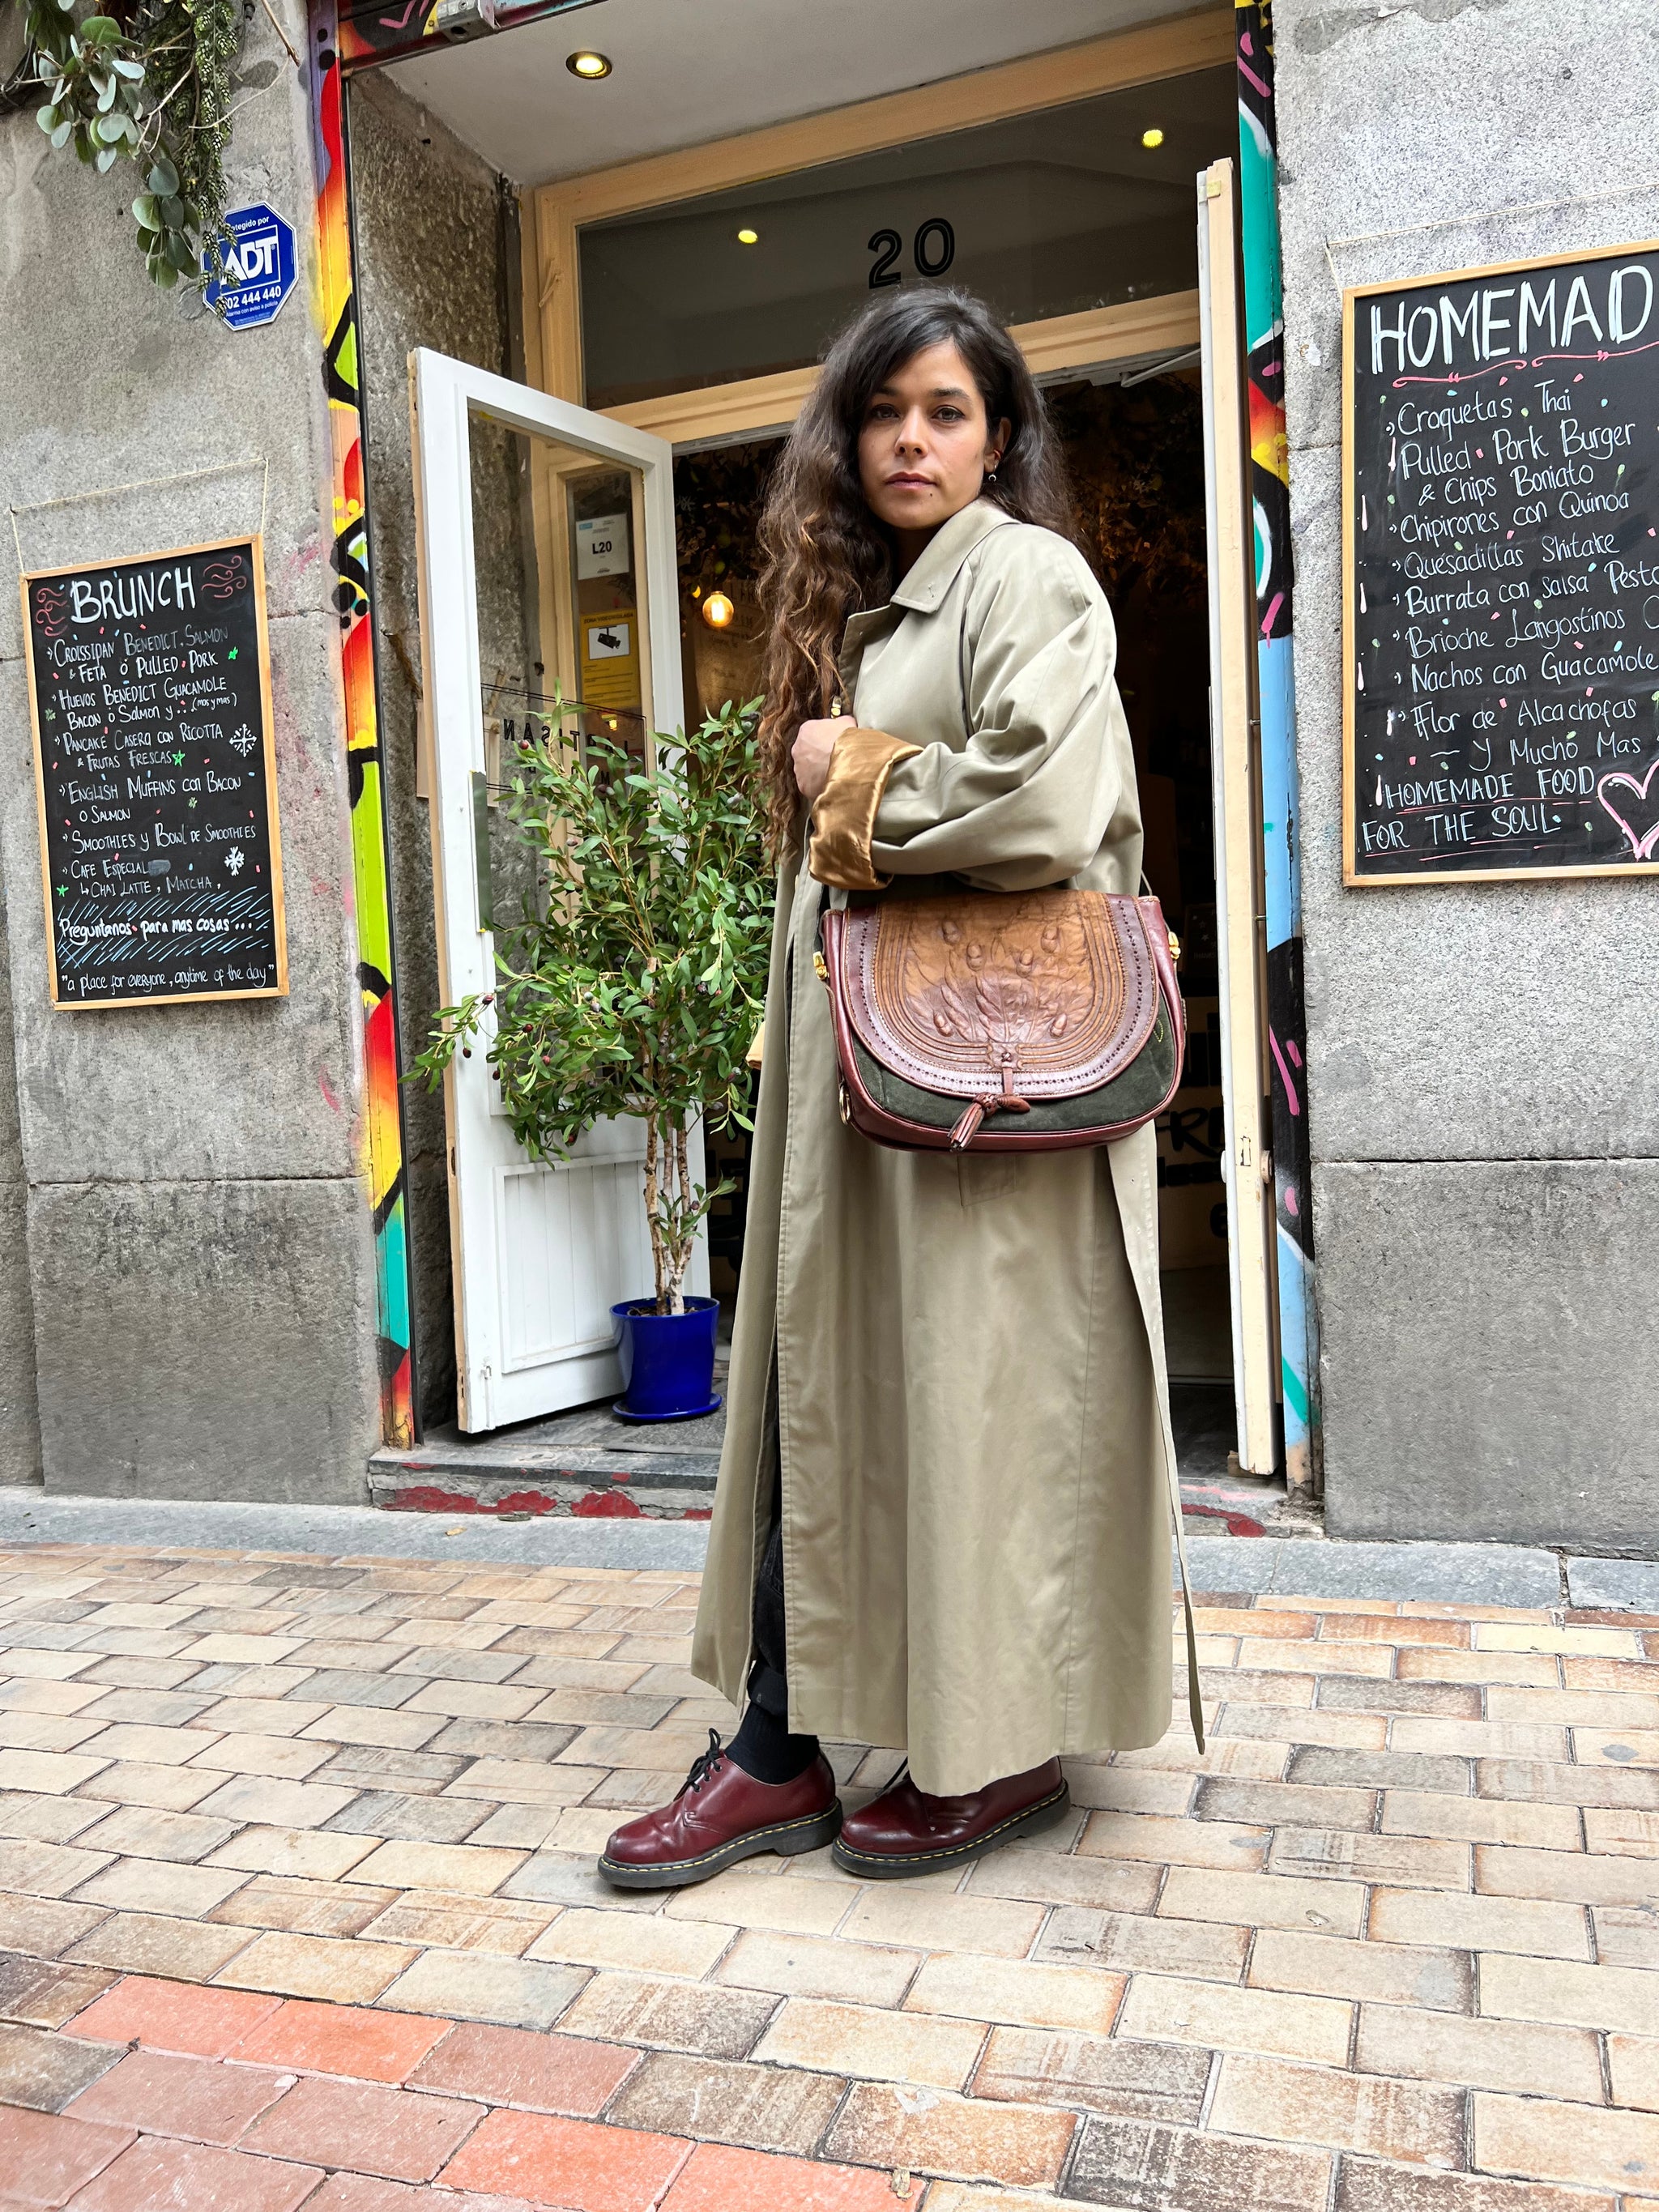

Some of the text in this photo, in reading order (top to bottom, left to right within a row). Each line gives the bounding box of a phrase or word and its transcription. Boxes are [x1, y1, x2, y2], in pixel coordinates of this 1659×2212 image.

[231, 215, 269, 231] otegido por
[220, 236, 278, 286] ADT
[868, 217, 955, 289] 20
[227, 285, 282, 309] 02 444 440
[1371, 265, 1653, 374] HOMEMAD
[1398, 379, 1571, 442] Croquetas Thai
[1401, 418, 1636, 480] Pulled Pork Burger
[1418, 463, 1594, 506] & Chips Boniato
[1400, 491, 1630, 547] Chipirones con Quinoa
[592, 541, 612, 554] L20
[1403, 531, 1620, 579] Quesadillas Shitake
[70, 566, 196, 624] BRUNCH
[1405, 581, 1491, 617] Burrata
[1499, 581, 1530, 603] con
[1542, 575, 1589, 600] salsa
[185, 624, 228, 646] SALMON
[1405, 625, 1494, 659] Brioche
[1505, 607, 1625, 650] Langostinos
[78, 663, 107, 684] FETA
[136, 657, 178, 679] PULLED
[189, 650, 219, 673] PORK
[1411, 646, 1659, 693] Nachos con Guacamole
[58, 676, 228, 710] HUEVOS BENEDICT GUACAMOLE
[66, 711, 102, 731] BACON
[1413, 698, 1636, 740] Flor de Alcachofas
[62, 732, 108, 756] PANCAKE
[87, 754, 121, 773] FRUTAS
[128, 749, 172, 769] FRESCAS
[1510, 736, 1578, 766] Mucho
[1597, 731, 1641, 758] Mas
[68, 780, 119, 805] ENGLISH
[127, 775, 177, 799] MUFFINS
[206, 770, 241, 794] BACON
[1384, 765, 1596, 809] HOMEMADE FOOD
[91, 805, 131, 824] SALMON
[1362, 802, 1561, 852] FOR THE SOUL
[71, 830, 136, 854] SMOOTHIES
[205, 823, 257, 842] SMOOTHIES
[71, 859, 149, 880] CAFE ESPECIAL
[91, 881, 117, 897] CHAI
[59, 918, 132, 946] Preguntanos
[140, 918, 168, 941] para
[172, 919, 193, 933] mas
[80, 973, 108, 997] place
[111, 975, 125, 995] for
[175, 966, 208, 990] anytime
[214, 969, 224, 987] of
[227, 964, 241, 982] the
